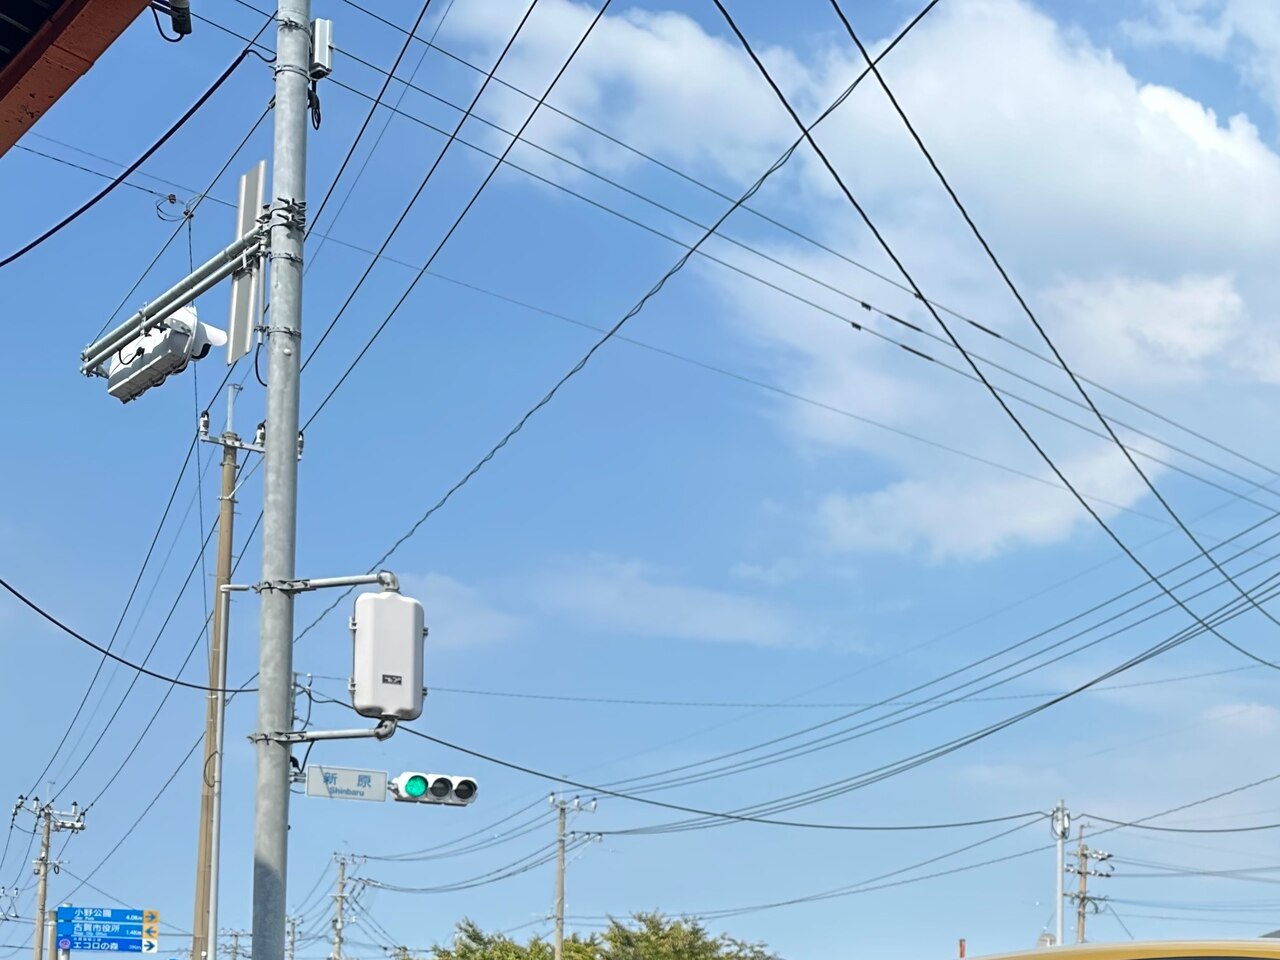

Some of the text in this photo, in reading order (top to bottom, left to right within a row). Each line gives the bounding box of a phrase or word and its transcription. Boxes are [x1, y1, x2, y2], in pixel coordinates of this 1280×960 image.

[74, 908, 112, 918] 小野公園
[74, 942, 119, 951] エコロの森
